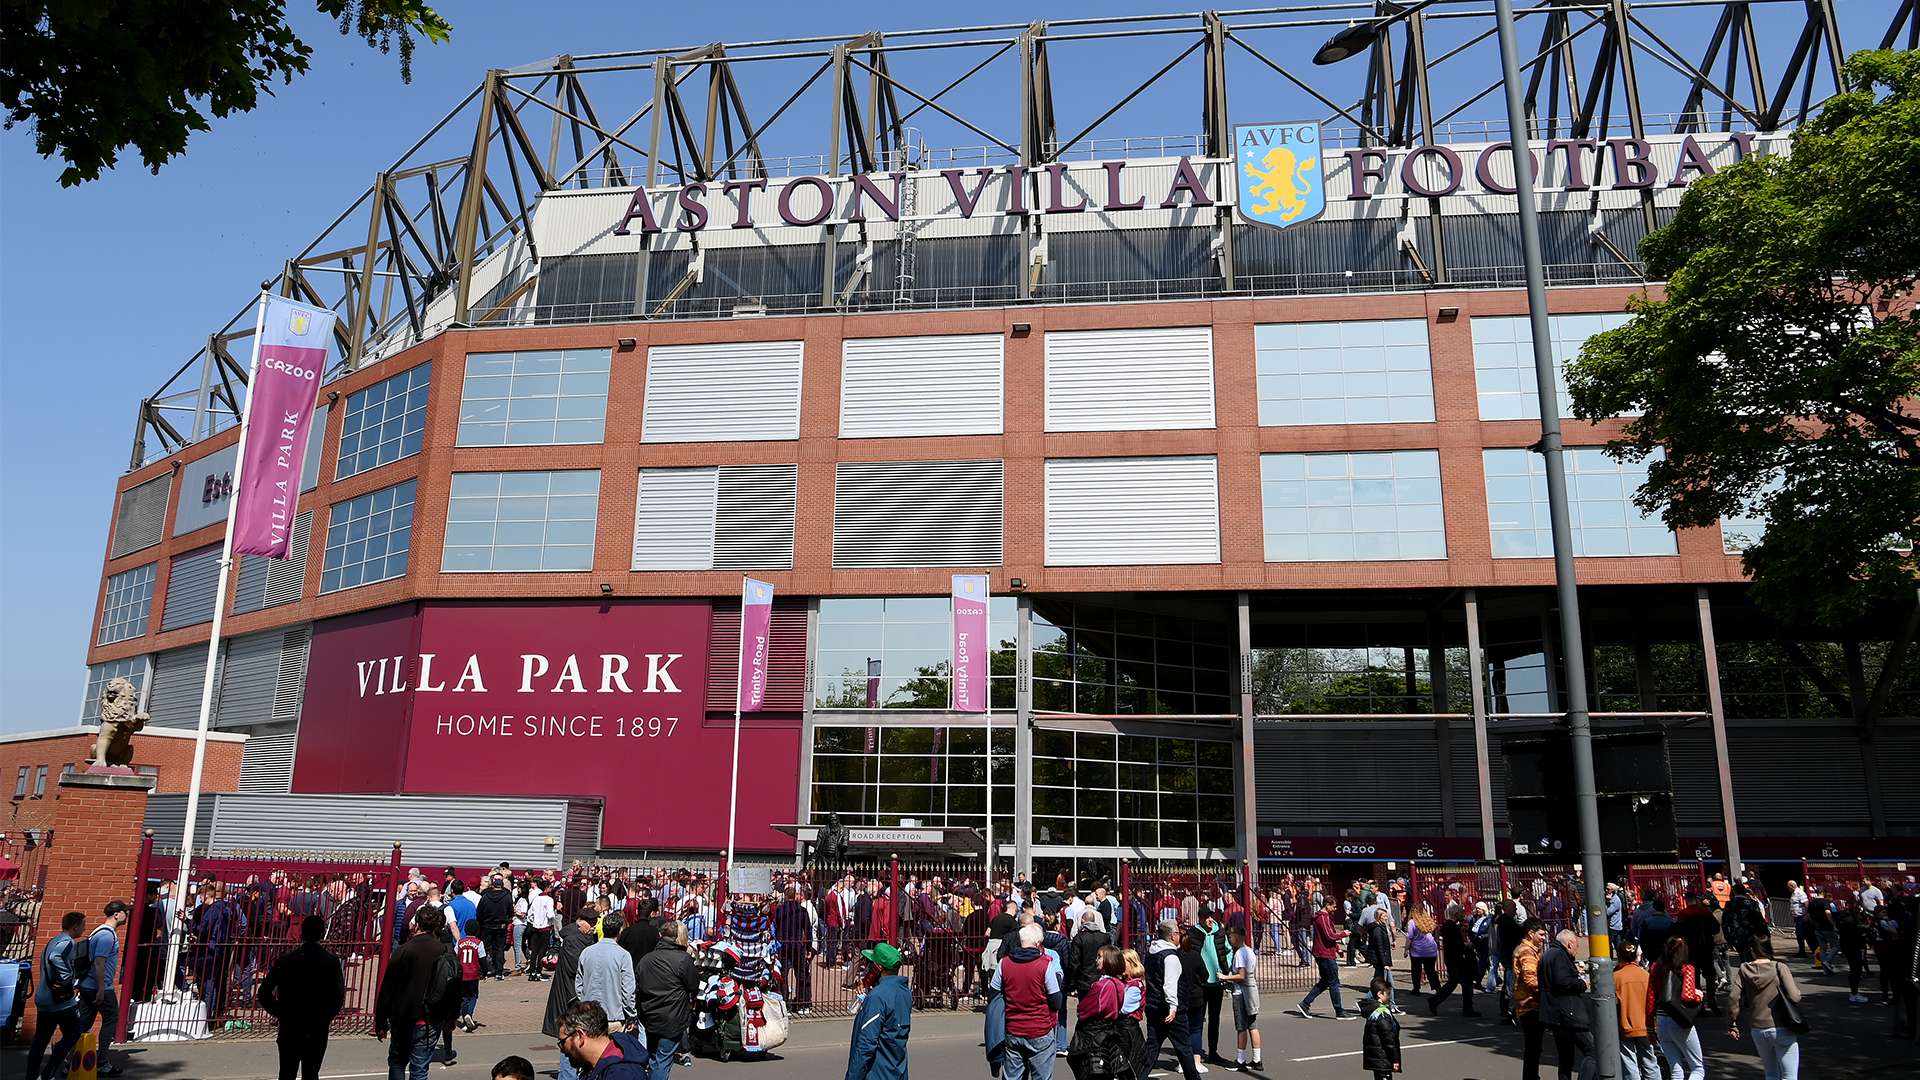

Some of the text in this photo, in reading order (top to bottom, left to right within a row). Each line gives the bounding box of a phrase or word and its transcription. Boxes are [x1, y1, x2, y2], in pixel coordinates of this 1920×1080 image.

[1241, 125, 1315, 147] AVFC
[614, 172, 905, 236] ASTON
[940, 156, 1214, 219] VILLA
[264, 358, 315, 380] CAZOO
[271, 409, 300, 545] VILLA PARK
[357, 653, 684, 698] VILLA PARK
[752, 636, 766, 705] Trinity Road
[436, 714, 679, 737] HOME SINCE 1897
[1335, 845, 1375, 854] CAZOO
[463, 950, 472, 963] 11
